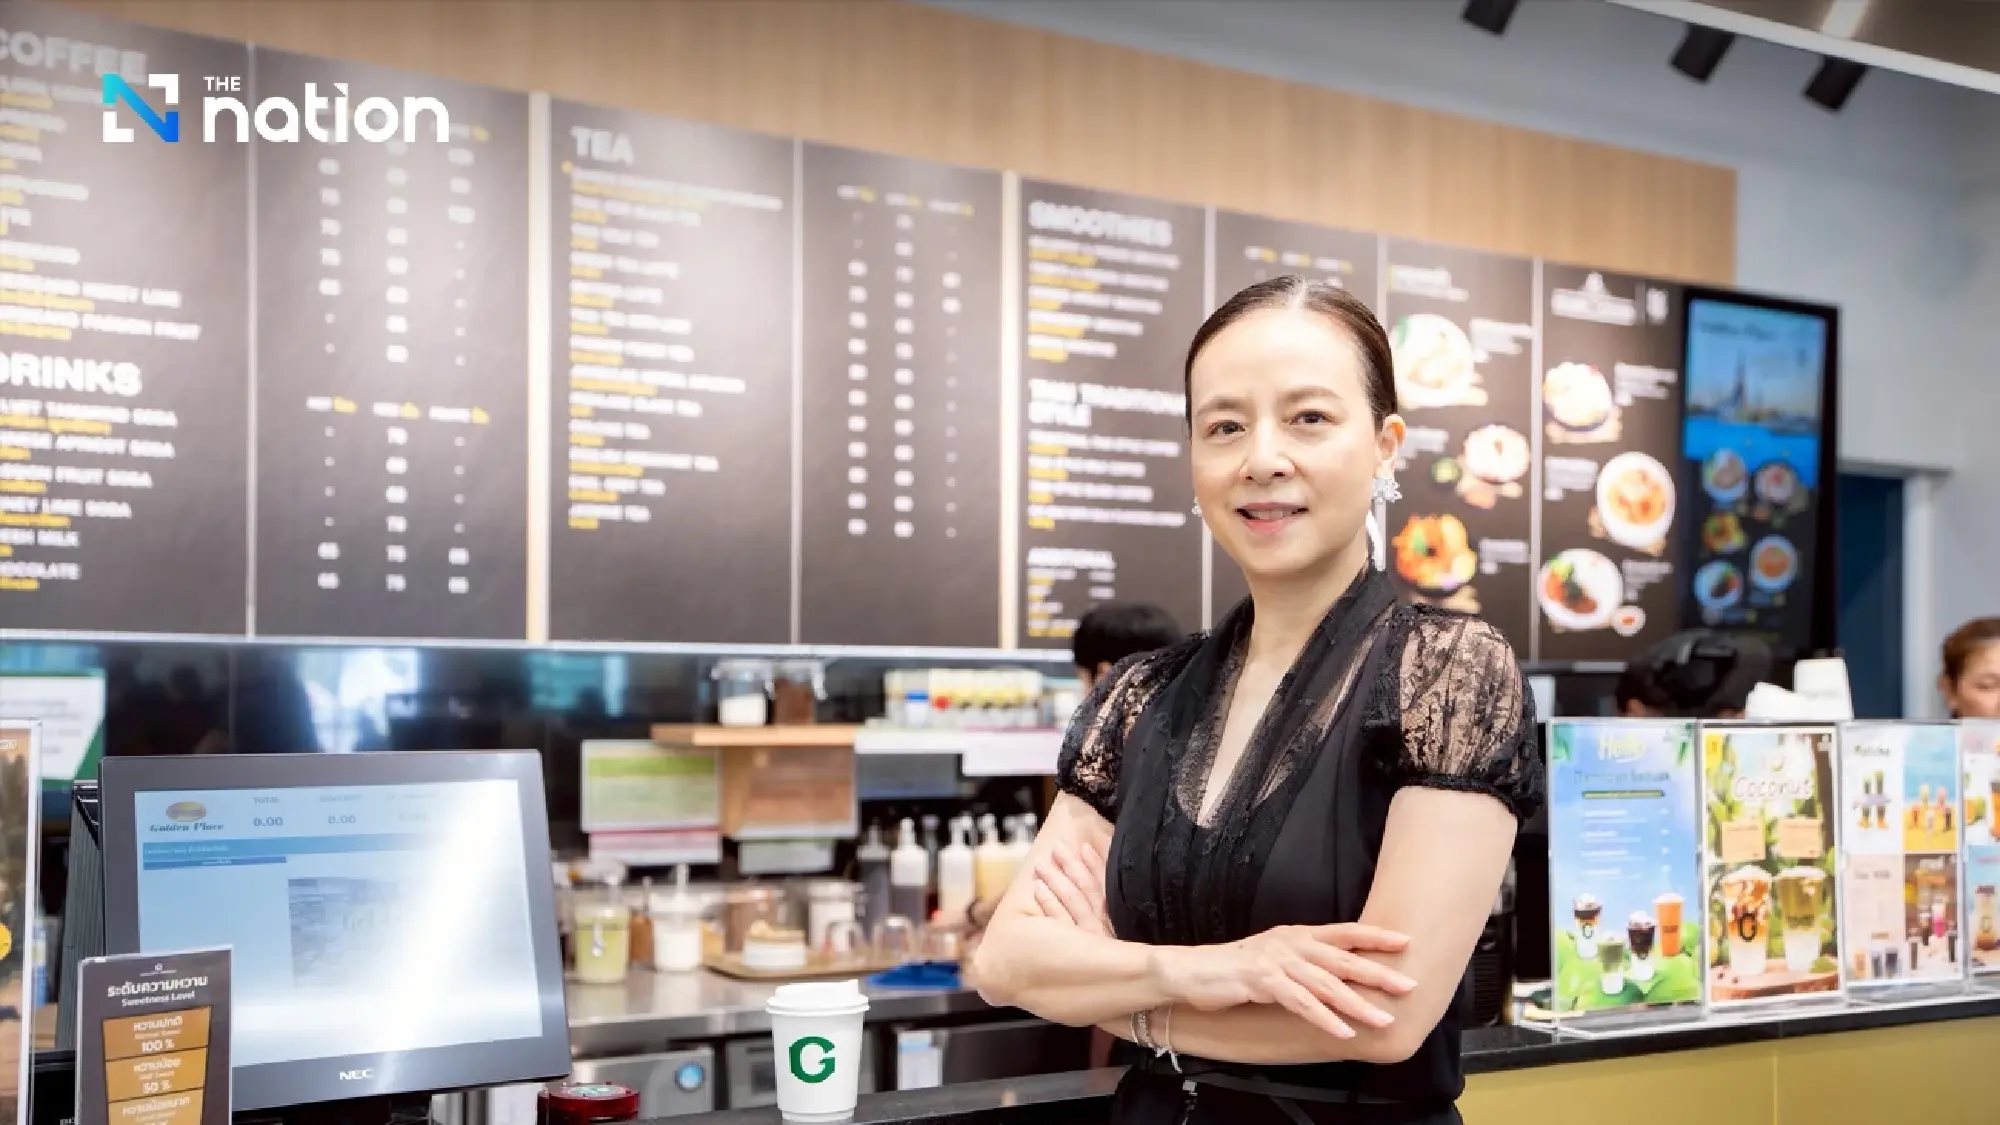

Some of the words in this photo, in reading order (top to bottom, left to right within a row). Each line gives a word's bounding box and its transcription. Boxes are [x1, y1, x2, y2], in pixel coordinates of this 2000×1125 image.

[253, 816, 284, 827] 0.00
[121, 994, 170, 1007] Sweetness
[171, 990, 195, 1002] Level
[142, 1039, 163, 1053] 100
[789, 1036, 836, 1084] G
[339, 1069, 373, 1080] NEC
[143, 1081, 159, 1095] 50
